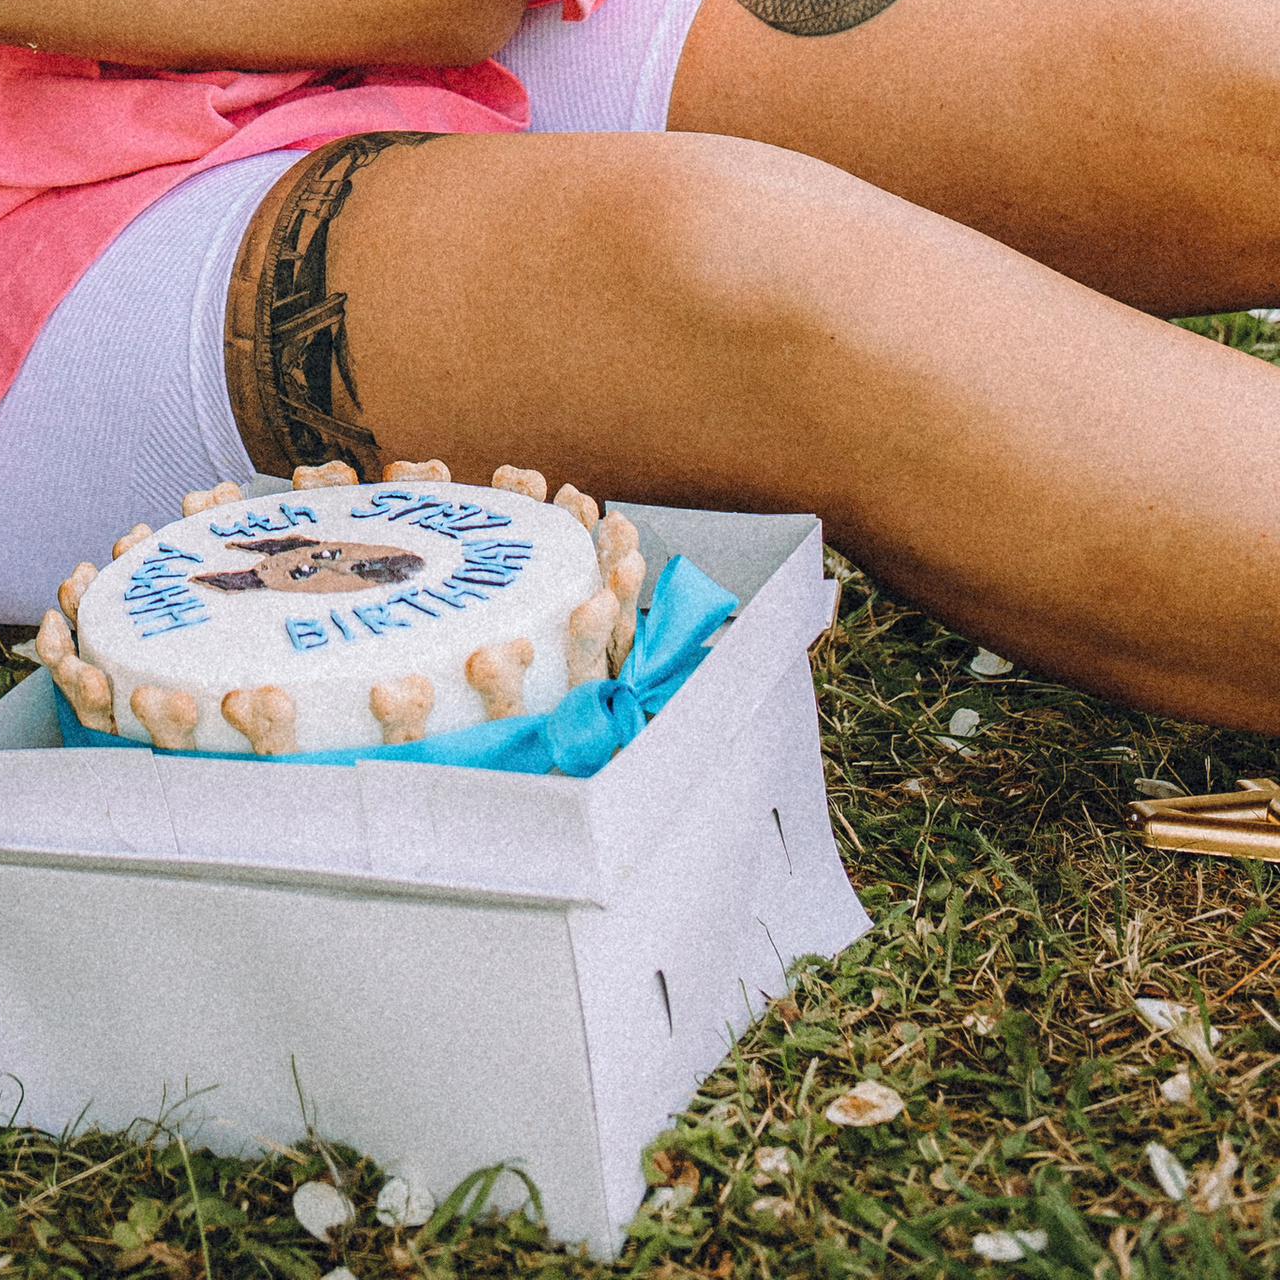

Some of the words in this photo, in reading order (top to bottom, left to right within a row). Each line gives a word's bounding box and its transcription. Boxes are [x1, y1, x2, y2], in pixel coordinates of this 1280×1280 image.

[124, 542, 211, 638] HAPPY
[208, 502, 318, 539] 4th
[285, 538, 535, 651] BIRTHDAY
